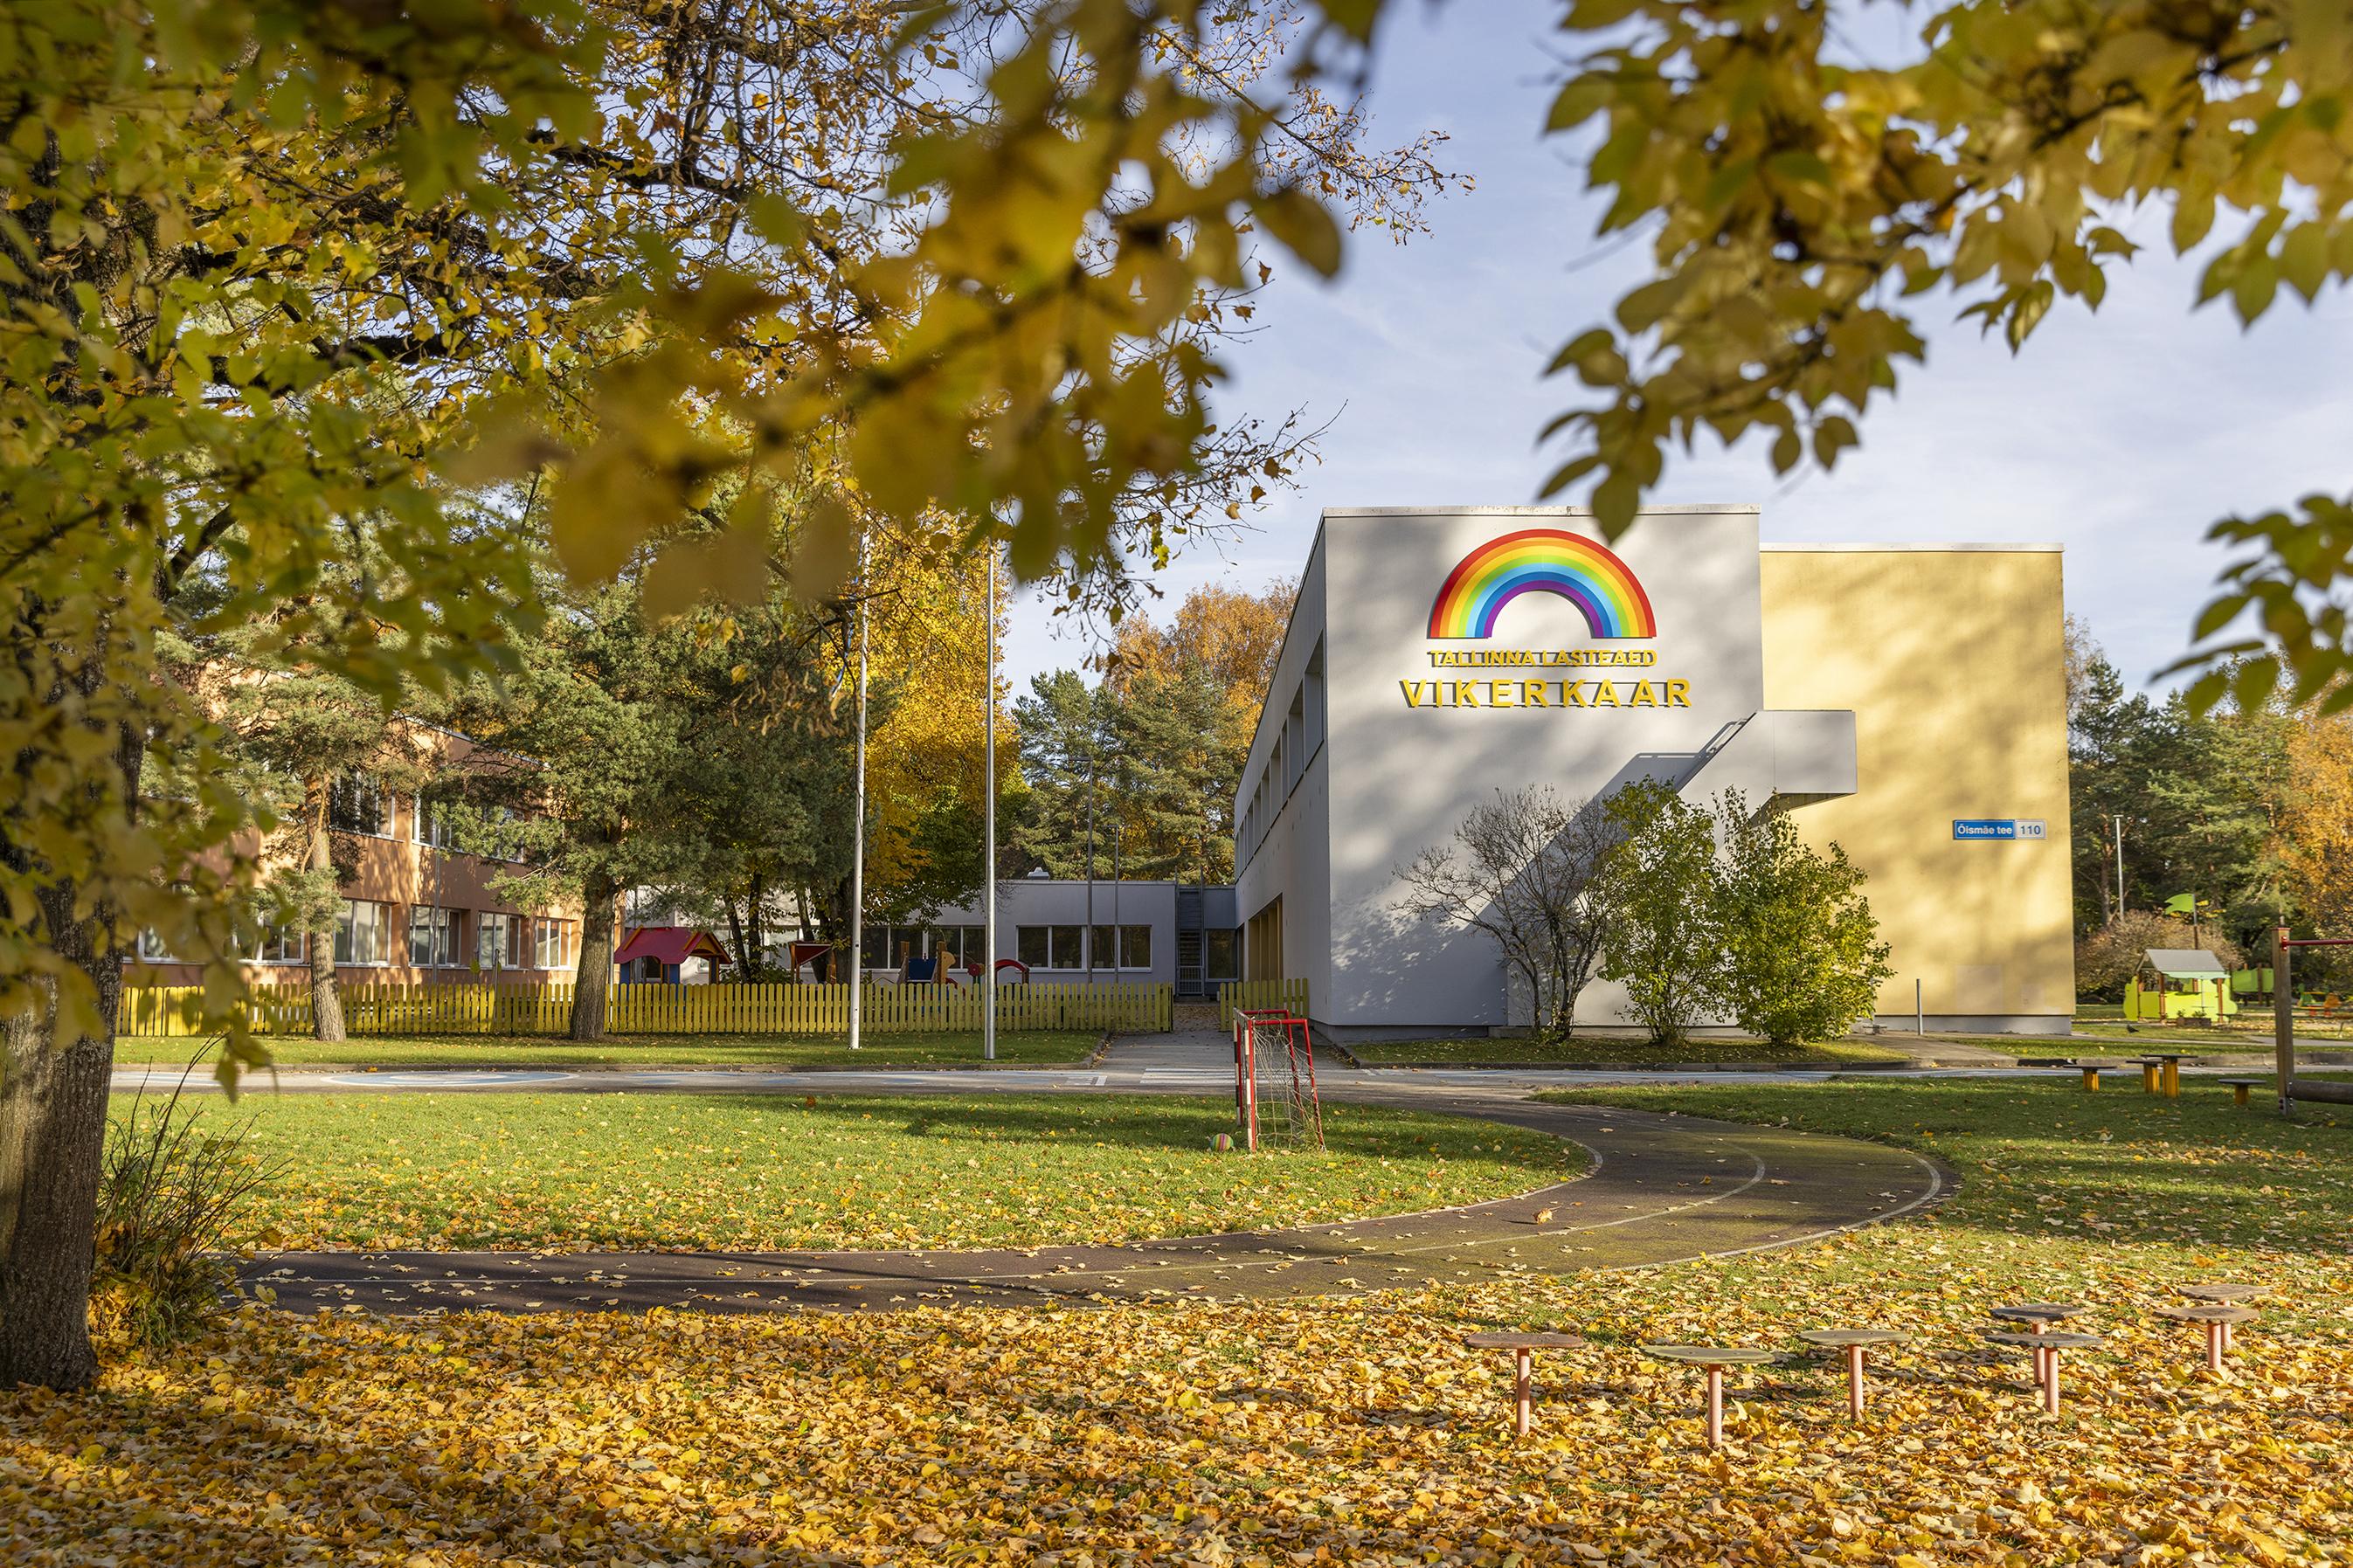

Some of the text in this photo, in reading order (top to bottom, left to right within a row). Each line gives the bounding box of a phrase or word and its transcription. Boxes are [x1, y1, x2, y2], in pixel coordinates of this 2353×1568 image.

[1430, 650, 1657, 667] TALLINNA LASTEAED
[1401, 679, 1692, 708] VIKERKAAR
[1957, 824, 2041, 834] Õismäe tee 110
